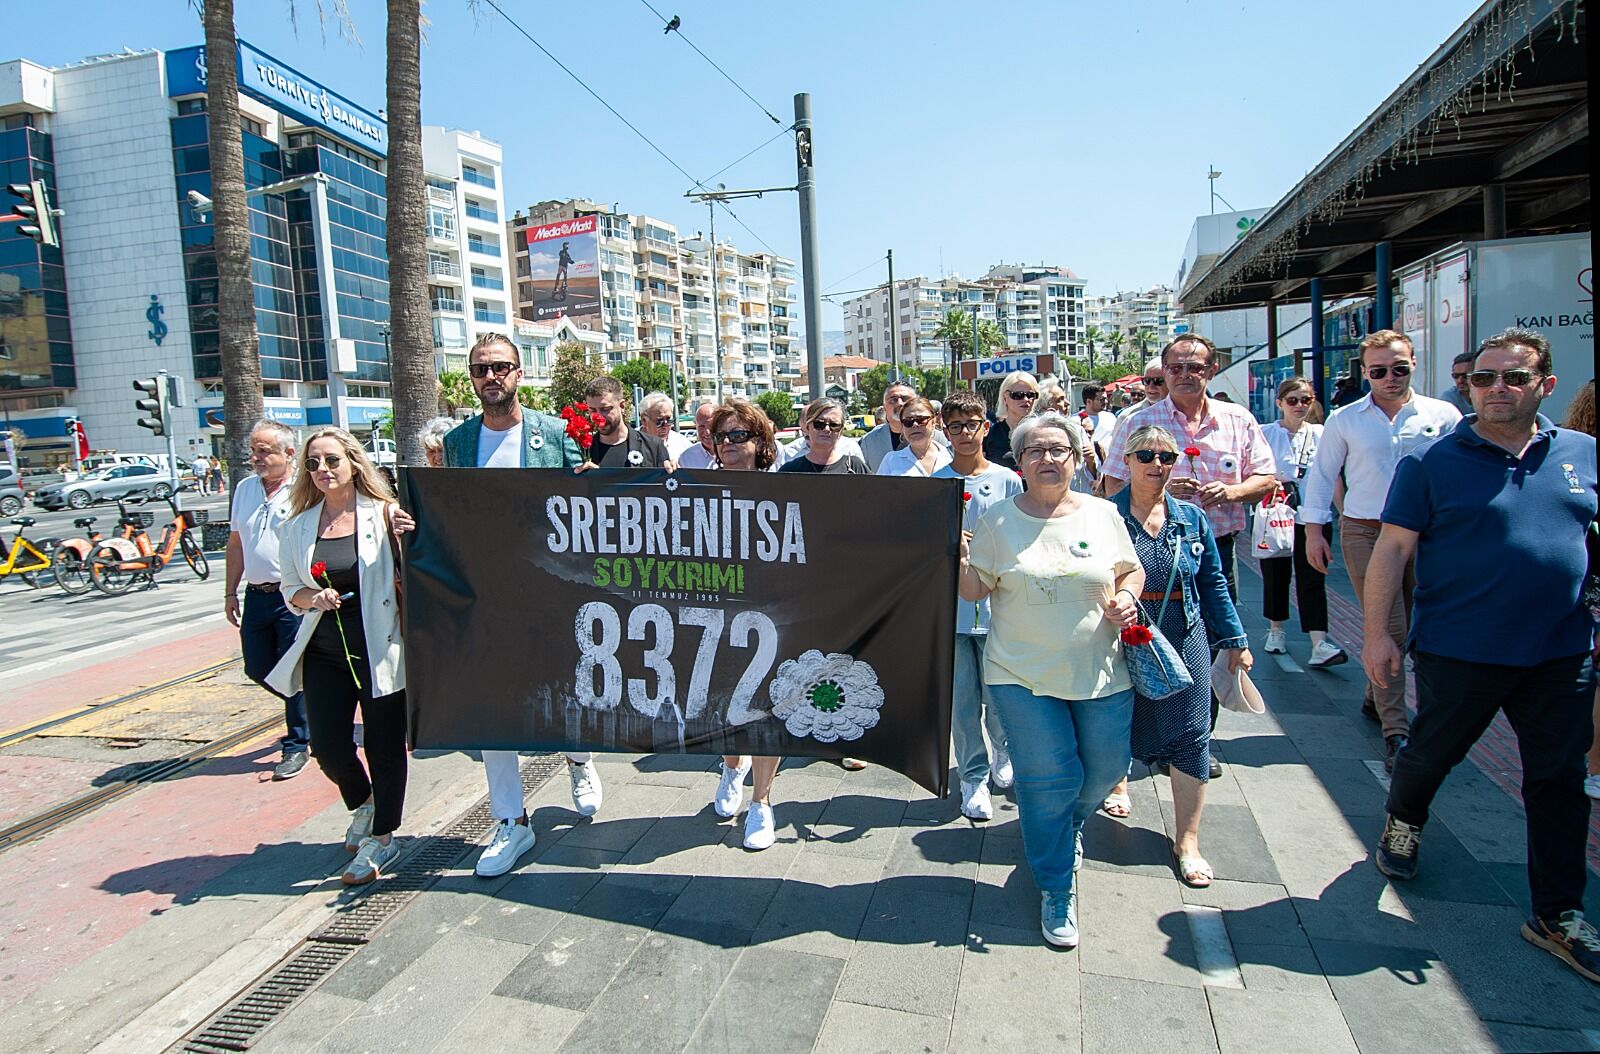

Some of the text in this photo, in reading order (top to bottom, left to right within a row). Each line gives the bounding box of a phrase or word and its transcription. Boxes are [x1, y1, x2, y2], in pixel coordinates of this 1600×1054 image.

[257, 63, 319, 110] TÜRKİYE
[332, 106, 382, 142] BANKASI
[1516, 315, 1553, 329] KAN
[546, 490, 807, 564] SREBRENİTSA
[592, 556, 745, 594] SOYKIRIMI
[632, 590, 720, 602] 11 TEMMUZ 1995
[574, 601, 778, 726] 8372
